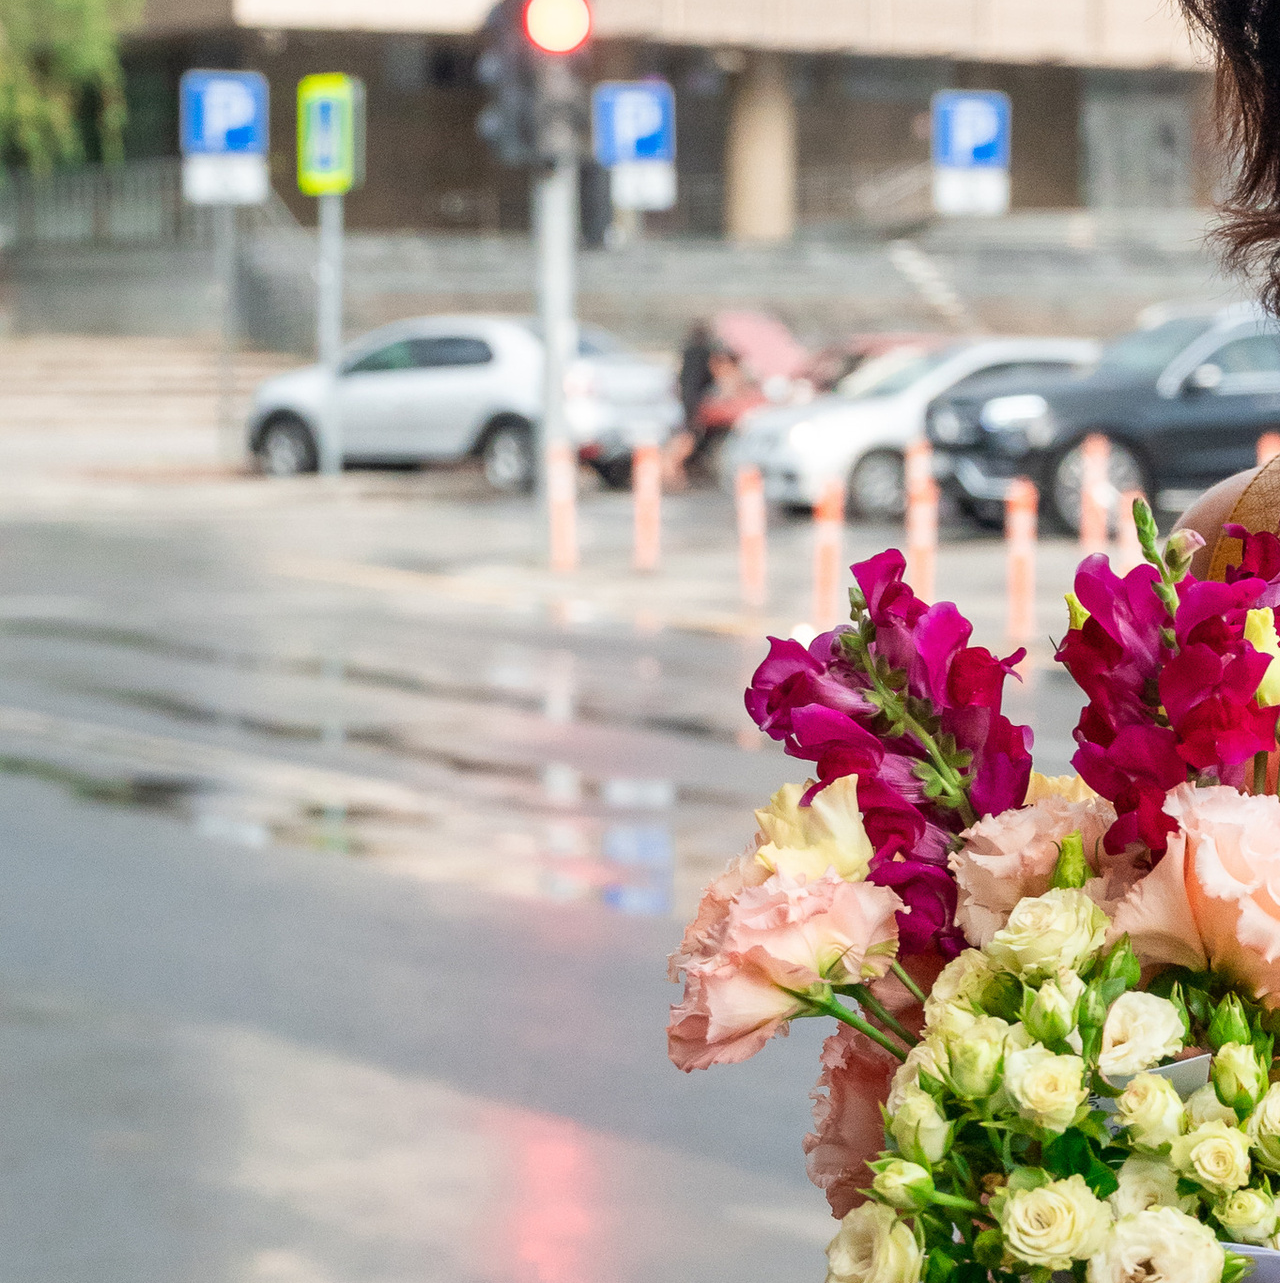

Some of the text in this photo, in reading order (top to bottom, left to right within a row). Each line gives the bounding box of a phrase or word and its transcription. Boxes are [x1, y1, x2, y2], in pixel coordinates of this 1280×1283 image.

[204, 79, 256, 152] P
[613, 89, 662, 161] P
[952, 98, 999, 167] P
